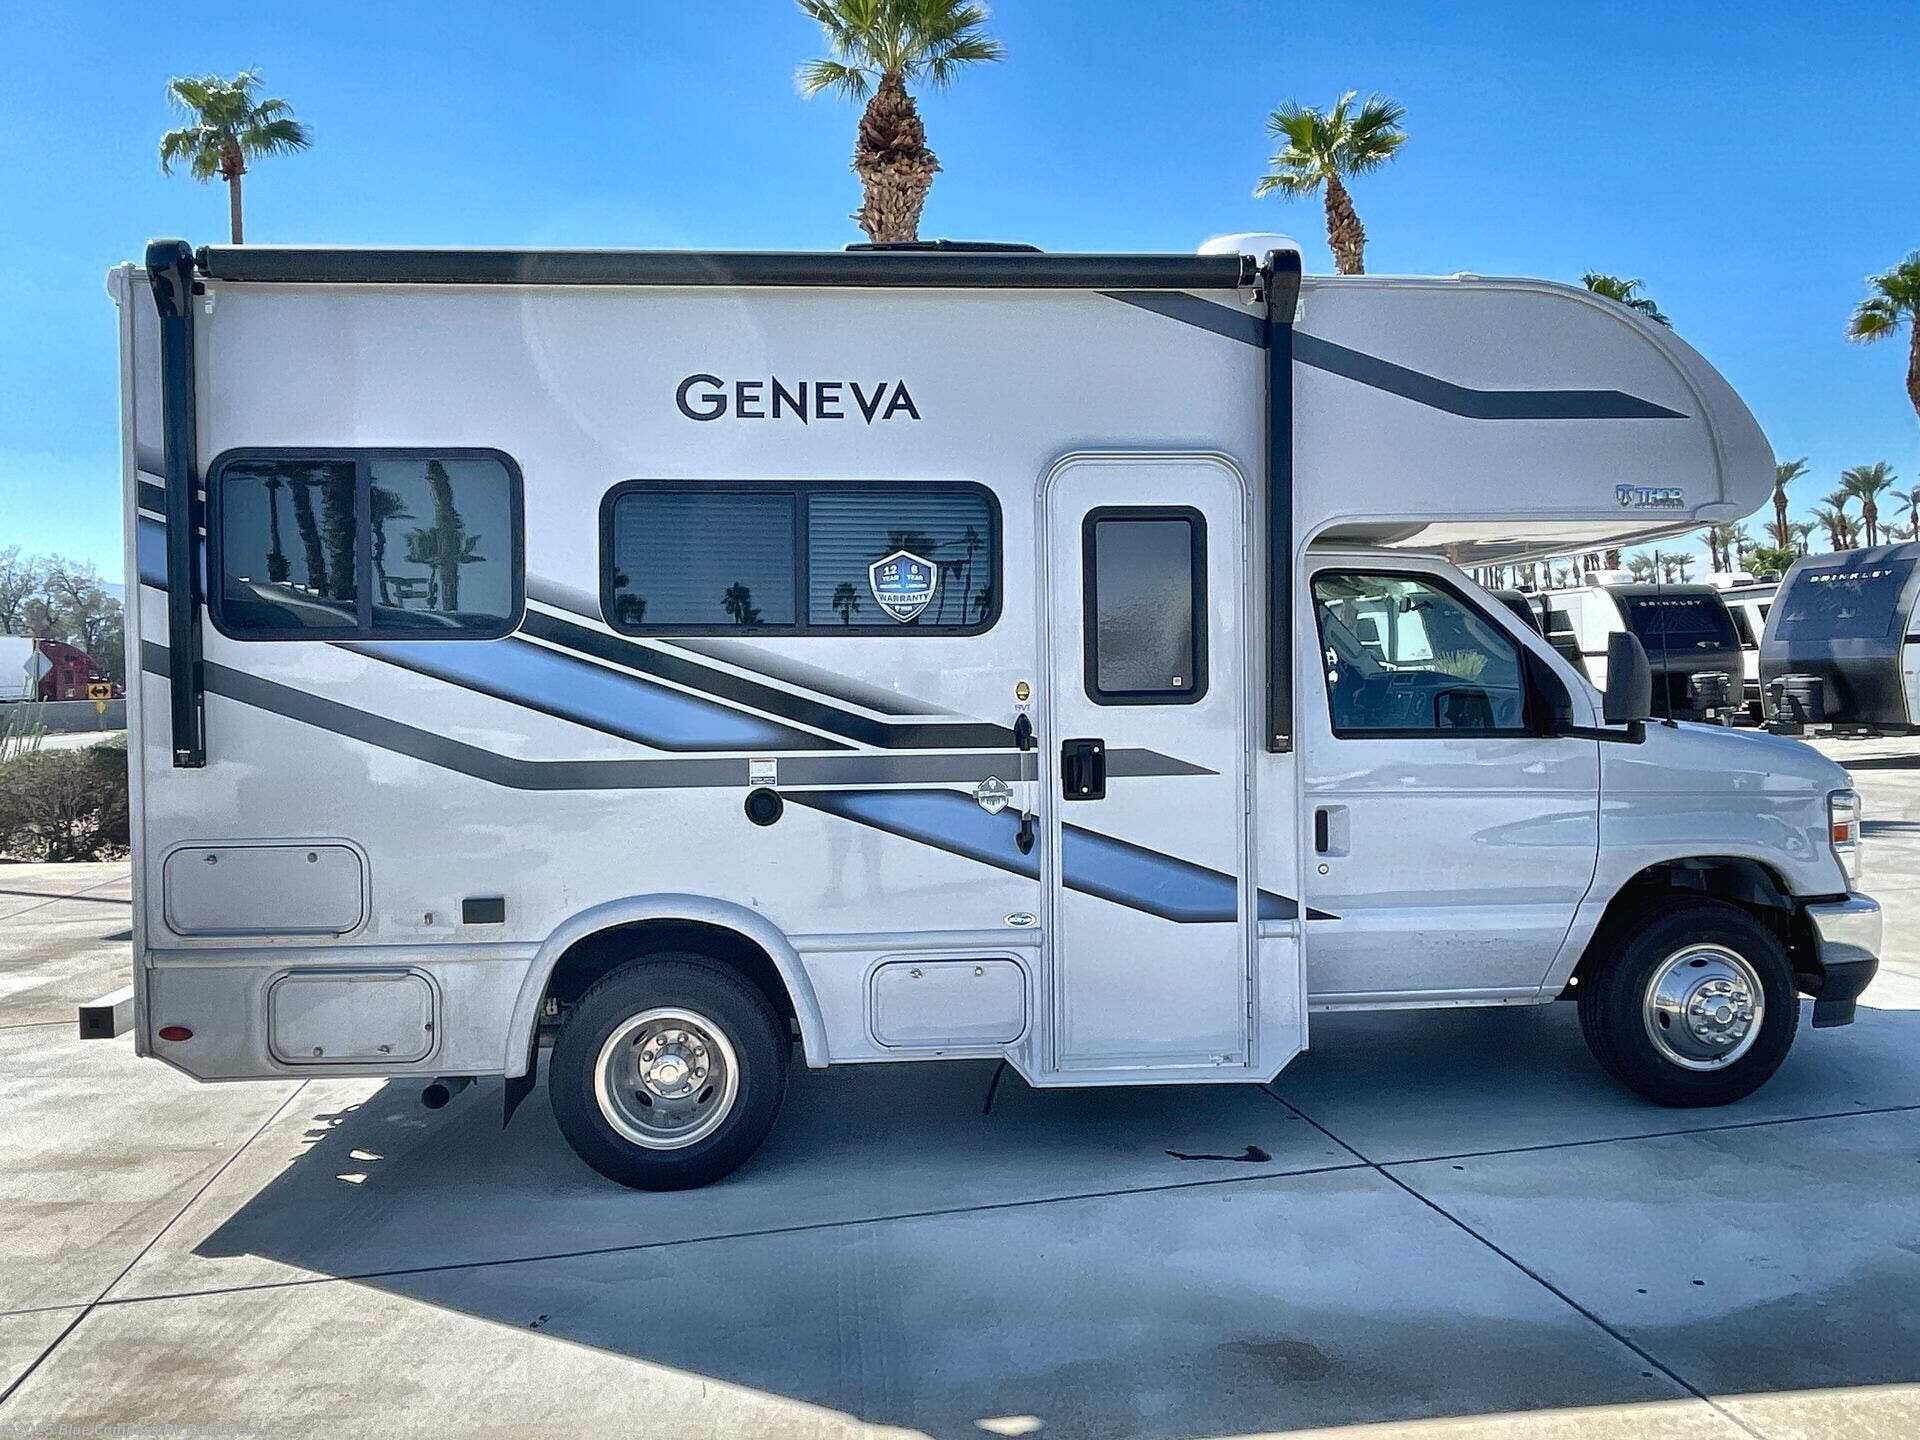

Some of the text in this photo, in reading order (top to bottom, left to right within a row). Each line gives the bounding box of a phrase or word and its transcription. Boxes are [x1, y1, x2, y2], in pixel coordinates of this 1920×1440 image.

[675, 373, 921, 425] GENEVA
[883, 564, 898, 576] 12
[1809, 569, 1893, 583] BRINKLEY
[879, 593, 928, 602] WARRANTY
